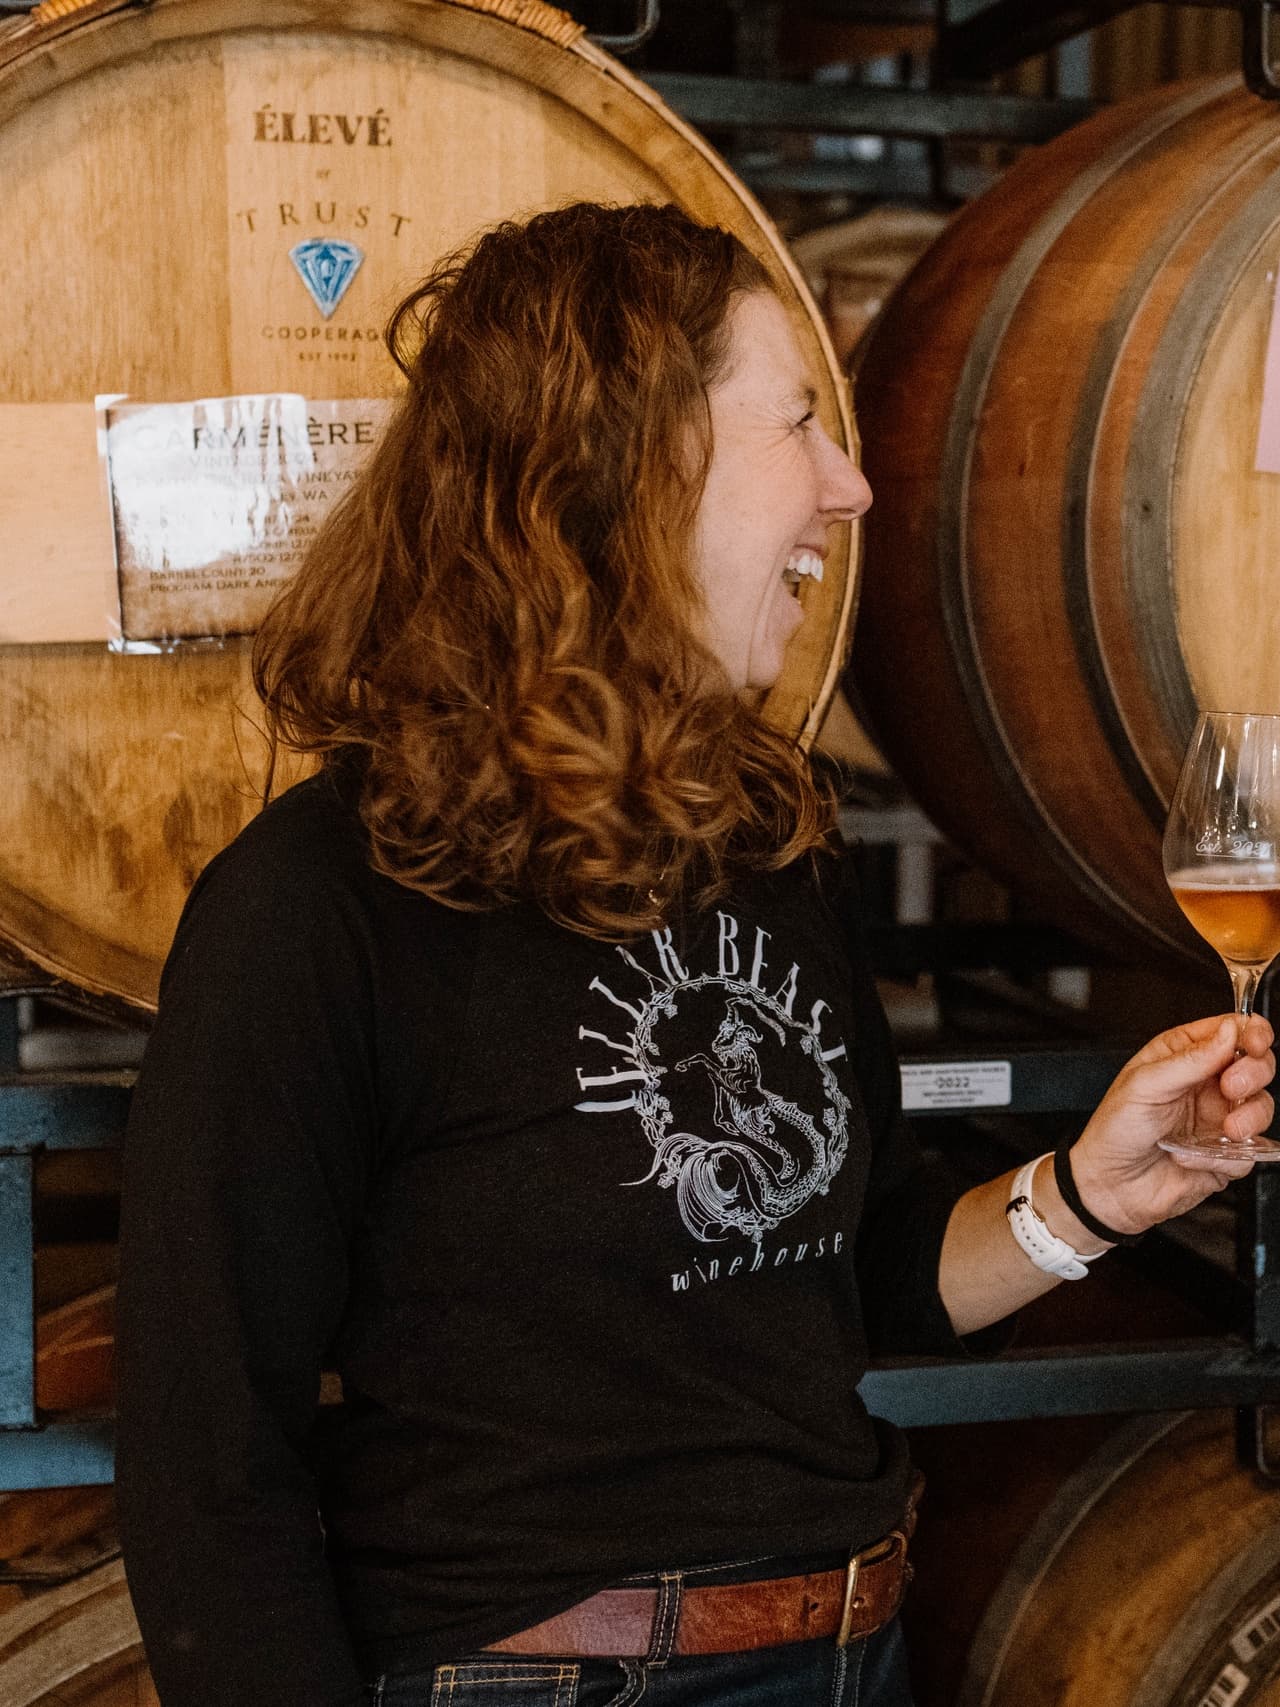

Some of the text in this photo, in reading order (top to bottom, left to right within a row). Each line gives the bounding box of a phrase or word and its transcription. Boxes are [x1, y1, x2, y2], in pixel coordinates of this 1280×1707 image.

[253, 103, 393, 147] ÉLEVÉ
[236, 200, 412, 238] TRUST
[261, 325, 386, 343] COOPERAG
[303, 490, 329, 501] WA
[716, 910, 849, 1062] BEAST
[670, 1231, 843, 1292] winehouse
